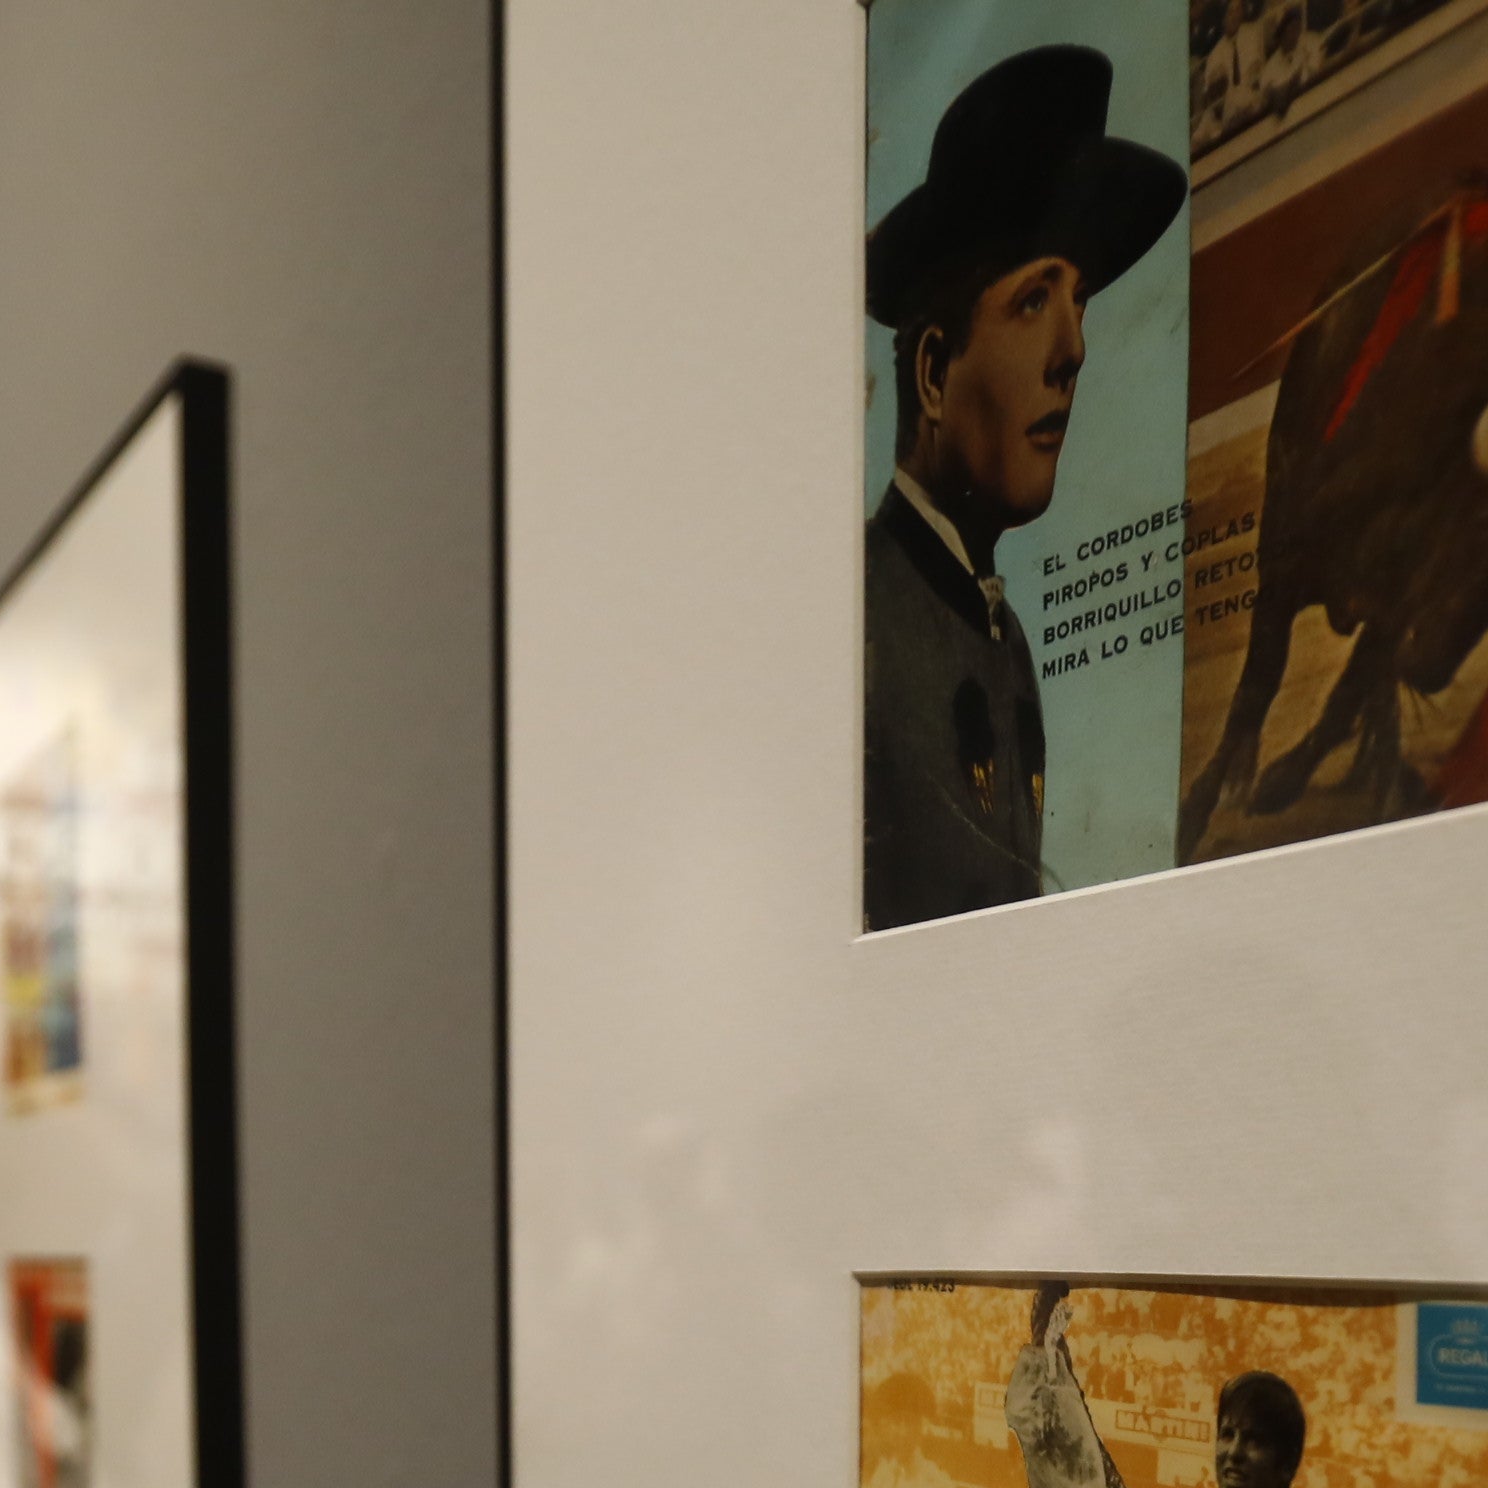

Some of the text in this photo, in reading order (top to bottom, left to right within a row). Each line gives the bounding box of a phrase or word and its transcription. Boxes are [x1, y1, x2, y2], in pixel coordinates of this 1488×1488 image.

[1043, 499, 1193, 577] EL CORDOBES
[1043, 511, 1255, 610] PIROPOS Y COPLAS
[1042, 588, 1257, 679] MIRA LO QUE TENG
[1043, 553, 1255, 645] BORRIQUILLO RETO
